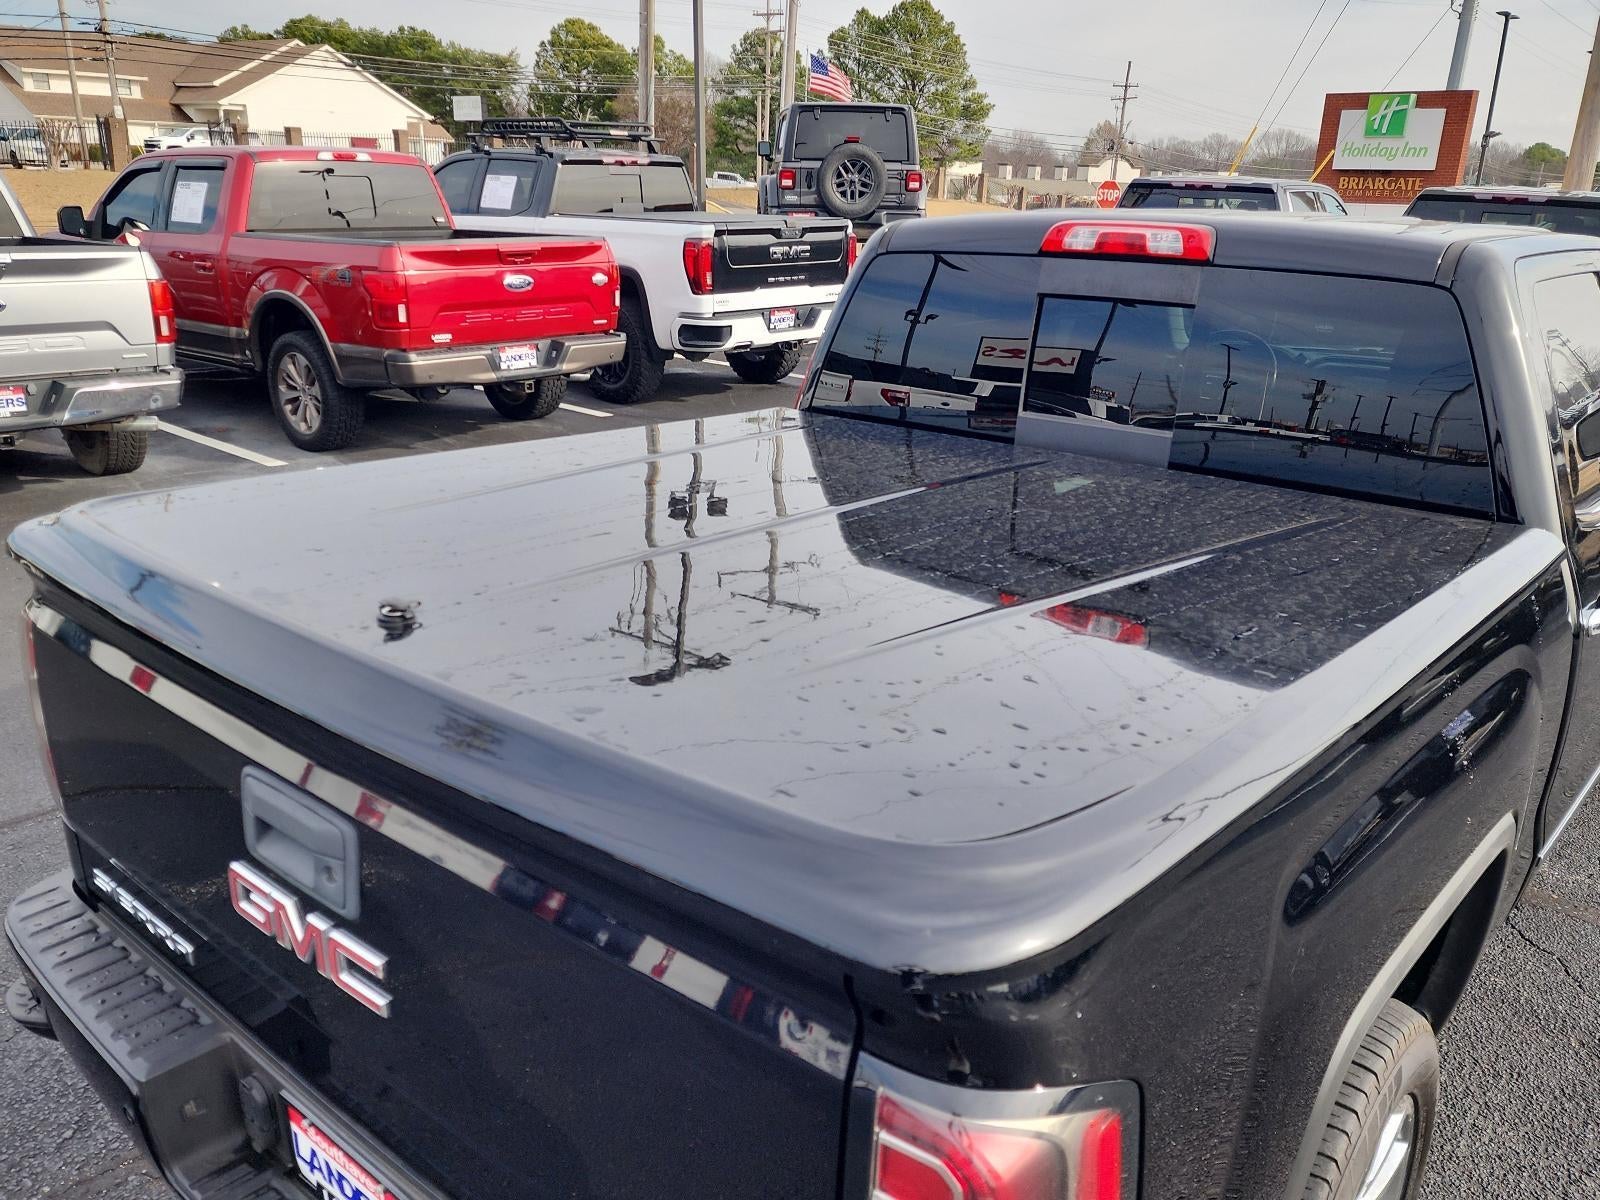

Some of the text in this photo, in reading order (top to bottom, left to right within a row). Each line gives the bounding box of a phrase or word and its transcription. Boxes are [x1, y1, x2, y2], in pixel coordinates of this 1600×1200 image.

[1341, 142, 1428, 161] Holiday Inn
[1339, 177, 1424, 190] BRIARGATE
[1098, 189, 1120, 201] STOP
[769, 245, 811, 260] GMC
[500, 353, 536, 363] LANDERS
[93, 868, 195, 965] SIERRA
[228, 861, 392, 1018] GMC
